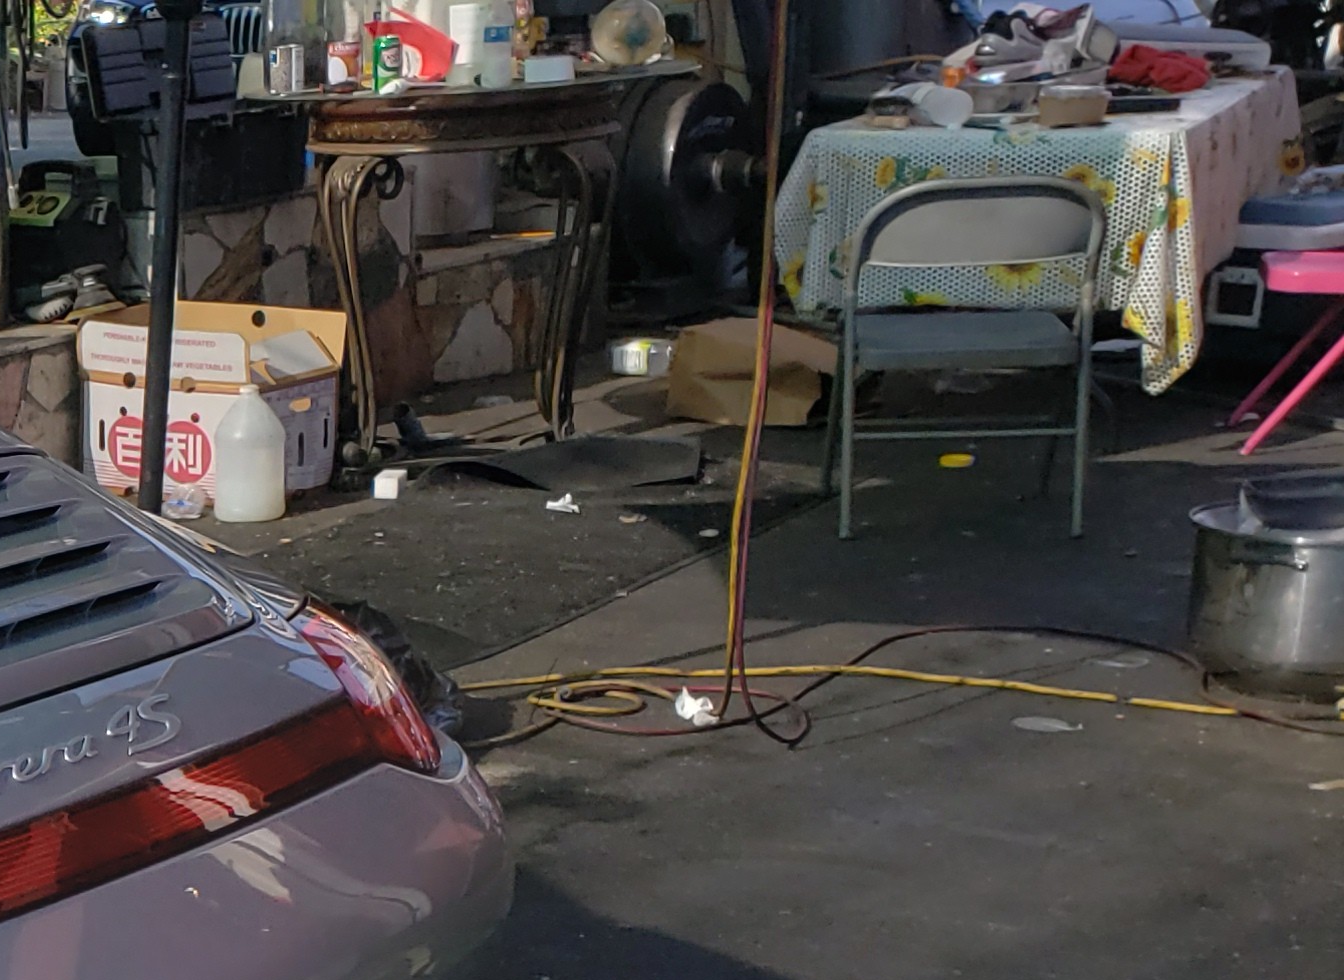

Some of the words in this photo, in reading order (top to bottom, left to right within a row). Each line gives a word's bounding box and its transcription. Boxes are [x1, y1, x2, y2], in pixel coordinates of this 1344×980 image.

[174, 338, 216, 349] RIGERATED
[185, 361, 233, 372] VEGETABLES
[106, 693, 182, 757] 4S
